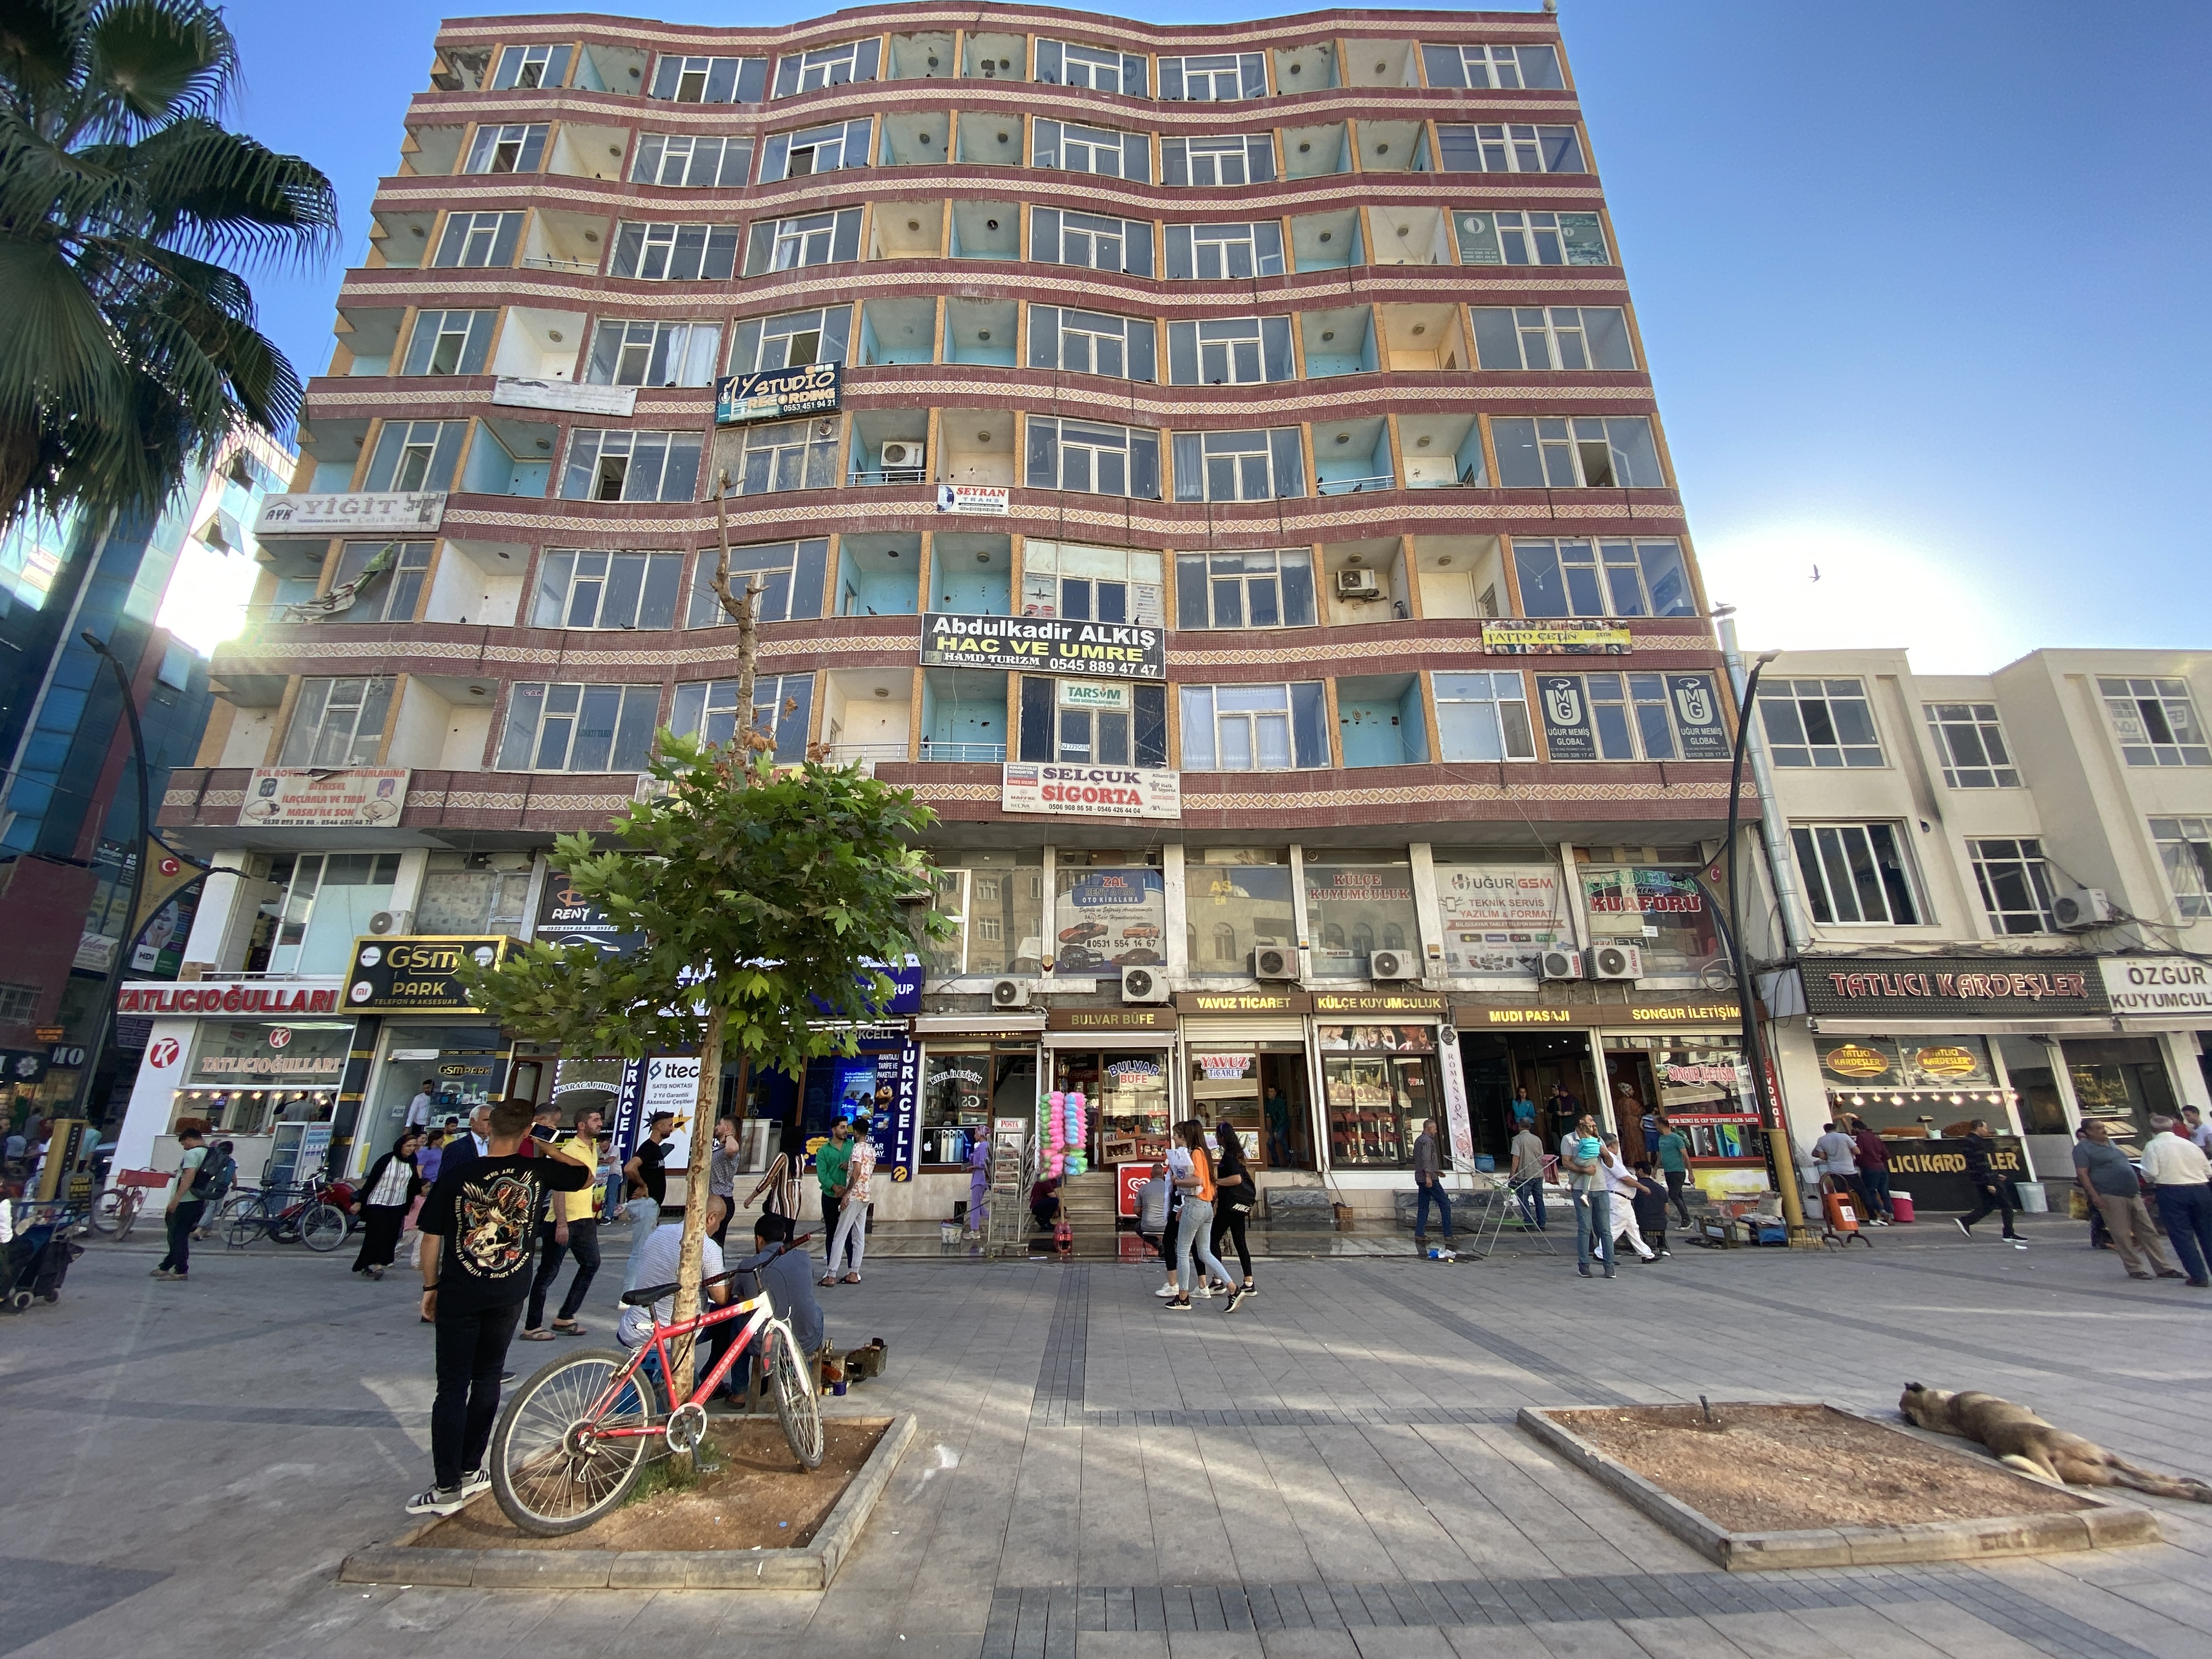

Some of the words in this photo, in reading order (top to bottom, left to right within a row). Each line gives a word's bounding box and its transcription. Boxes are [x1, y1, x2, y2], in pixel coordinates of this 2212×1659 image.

[755, 371, 836, 396] STUDIO
[956, 487, 1006, 497] SEYRAN
[304, 496, 397, 515] YİĞİT
[264, 510, 294, 520] AYK
[933, 617, 1073, 641] Abdulkadir
[1078, 625, 1156, 651] ALKIŞ
[1485, 632, 1533, 642] TATTO
[936, 636, 1000, 653] HAC
[1009, 640, 1049, 656] VE
[1059, 642, 1144, 662] UMRE
[944, 652, 985, 662] HAMD
[1049, 659, 1085, 672] 0545
[1088, 661, 1115, 673] 889
[1119, 663, 1136, 675] 47
[1141, 664, 1158, 676] 47
[1548, 727, 1567, 736] UĞUR
[1568, 727, 1590, 737] MEMİŞ
[1680, 726, 1700, 735] UĞUR
[1701, 727, 1723, 736] MEMİŞ
[1556, 737, 1585, 746] GLOBAL
[1690, 737, 1718, 745] GLOBAL
[1042, 768, 1142, 786] SELÇUK
[330, 795, 341, 804] VE
[1041, 781, 1144, 806] SİGORTA
[286, 808, 317, 817] MASAJ
[334, 808, 355, 816] SON
[1102, 876, 1128, 888] ZAL
[1333, 871, 1382, 889] KÜLÇE
[1472, 875, 1515, 889] UĞUR
[1517, 878, 1554, 889] GSM
[1085, 888, 1108, 896] RENT
[1118, 888, 1136, 896] CAR
[1310, 888, 1410, 901] KUYUMCULUK
[1469, 898, 1505, 907] TEKNİK
[1509, 897, 1545, 907] SERVİS
[1589, 892, 1702, 913] KUAFÖRÜ
[1460, 910, 1499, 918] YAZILIM
[1510, 910, 1553, 918] FORMAT
[1092, 939, 1110, 948] 0531
[1114, 939, 1130, 947] 554
[1133, 939, 1142, 947] 14
[1147, 939, 1156, 947] 67
[387, 946, 461, 969] GSM
[2126, 961, 2208, 985] ÖZGÜR
[392, 981, 447, 996] PARK
[1829, 973, 1933, 999] TATLICI
[1936, 973, 2089, 1002] KARDEŞLER
[117, 984, 335, 1012] TATLICIOĞULLARI
[1197, 997, 1237, 1009] YAVUZ
[1239, 995, 1291, 1009] TİCARET
[1318, 995, 1357, 1011] KÜLÇE
[1360, 998, 1441, 1009] KUYUMCULUK
[2109, 992, 2212, 1008] KUYUMCUL
[1071, 1014, 1119, 1025] BULVAR
[1122, 1012, 1155, 1025] BÜFE
[1632, 1008, 1686, 1020] SONGUR
[1688, 1005, 1741, 1021] İLETİŞİM
[1841, 1049, 1871, 1059] TATLICI
[201, 1054, 341, 1074] TATLICIOĞULLARI
[1108, 1060, 1160, 1077] BULVAR
[1200, 1056, 1249, 1068] YAVUZ
[1833, 1058, 1881, 1068] KARDEŞLER
[664, 1063, 699, 1079] ttec
[930, 1070, 950, 1085] KIZIL
[950, 1069, 983, 1085] İLETİŞİM
[1208, 1068, 1241, 1077] TİCARET
[1667, 1066, 1699, 1081] SONGUR
[1120, 1073, 1148, 1084] BÜFE
[557, 1082, 591, 1093] KARACA
[591, 1082, 620, 1094] PHONE
[1001, 1120, 1019, 1128] POSTA
[1921, 1153, 2021, 1173] KARDLER
[483, 1171, 499, 1181] WHO
[1232, 1203, 1251, 1212] NIKE
